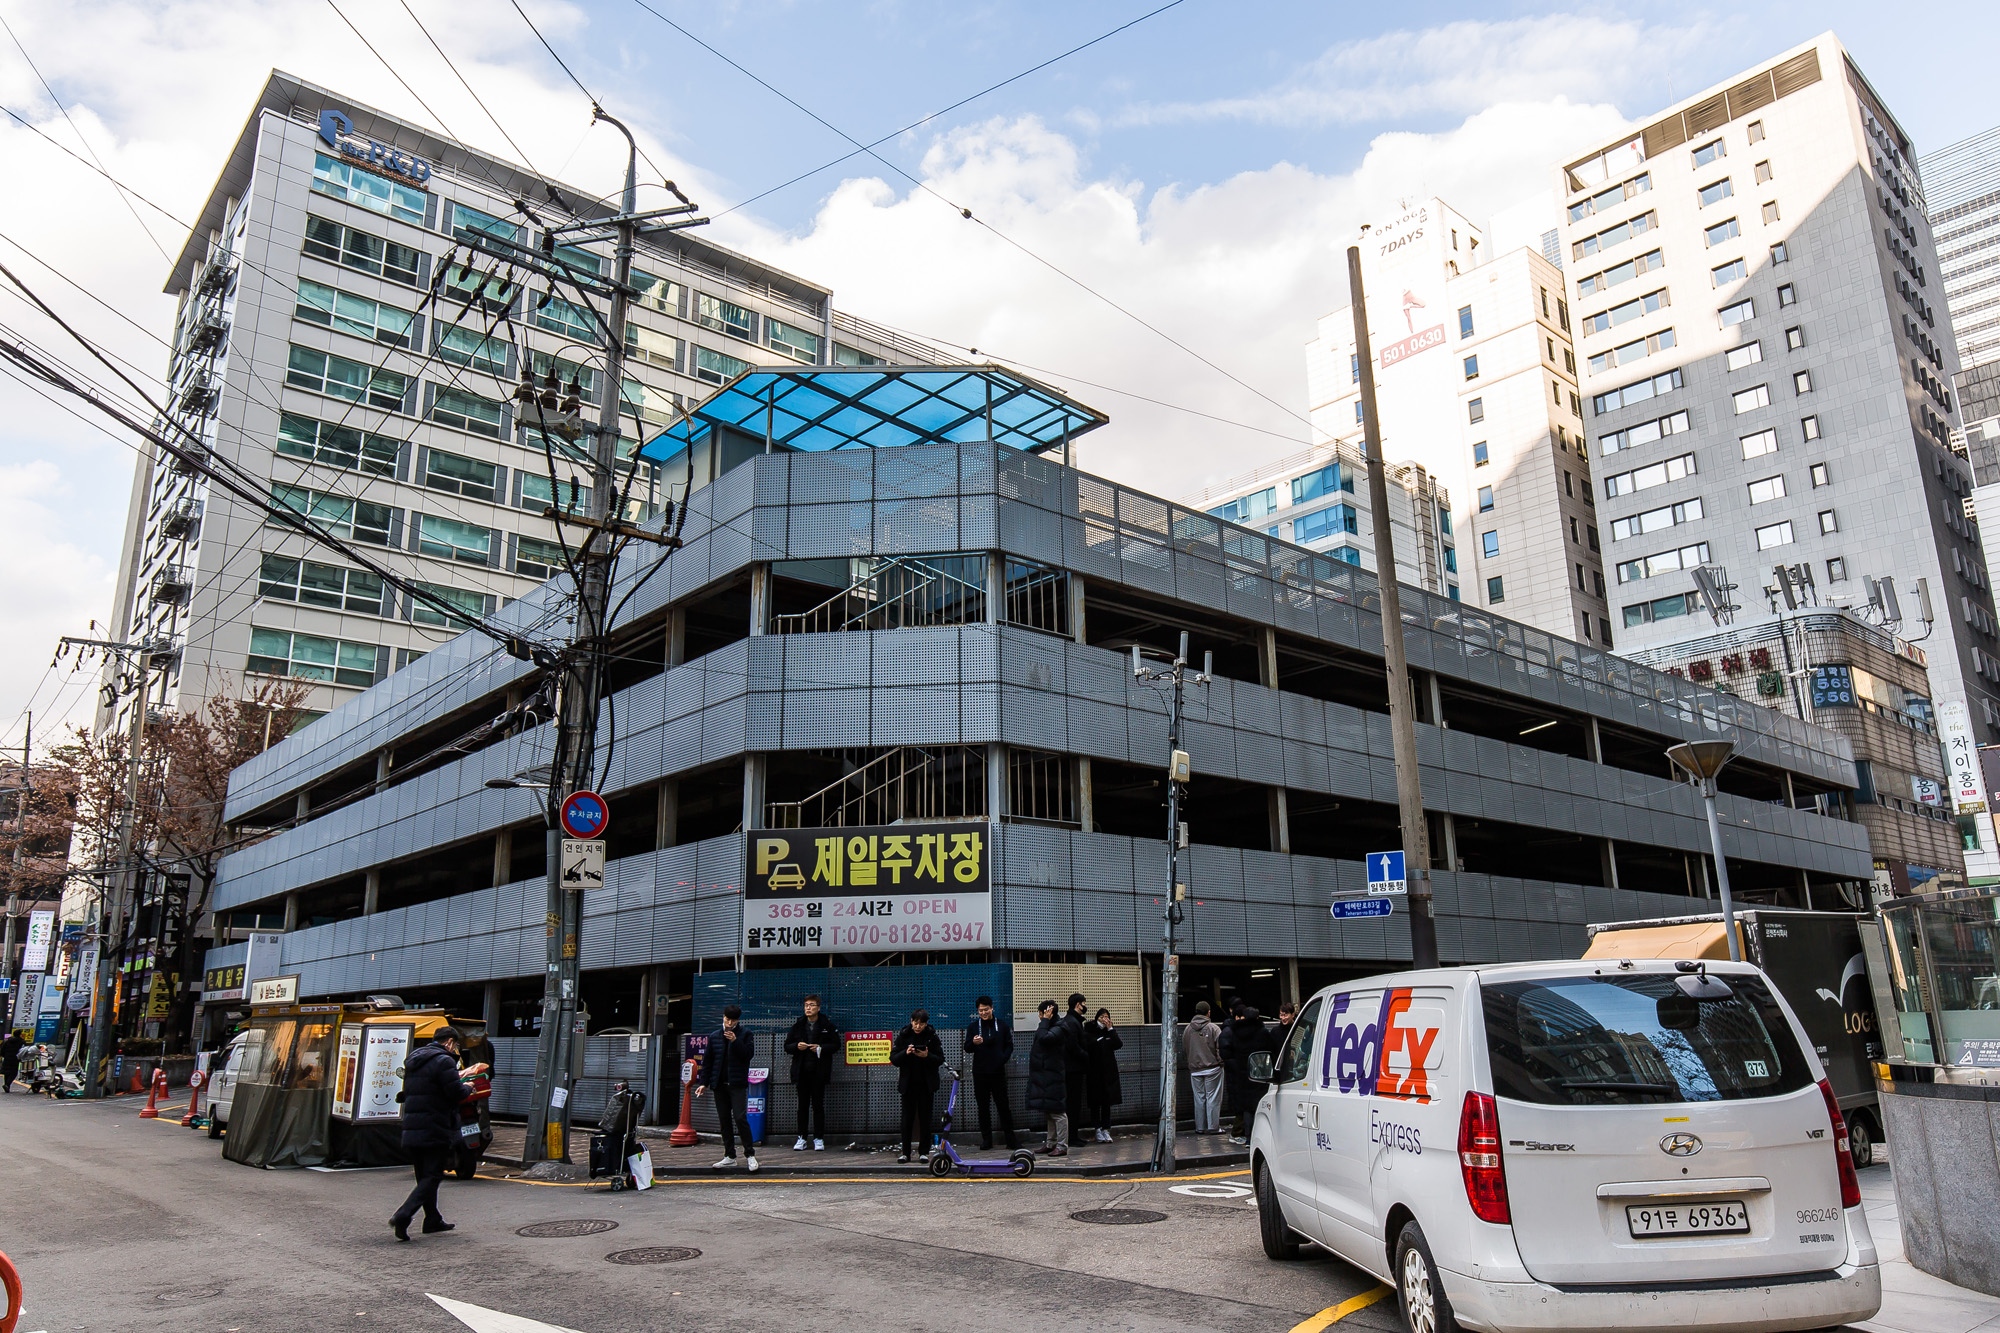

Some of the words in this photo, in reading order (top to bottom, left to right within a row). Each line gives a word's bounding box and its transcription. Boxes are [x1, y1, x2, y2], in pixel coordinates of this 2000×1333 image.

[342, 141, 365, 158] the
[368, 140, 431, 181] P&D
[1375, 224, 1392, 236] ON
[1395, 207, 1426, 226] YOGA
[1380, 228, 1424, 256] 7DAYS
[1383, 328, 1442, 363] 501.0630
[1949, 722, 1964, 732] the
[1952, 735, 1976, 788] 차이홍
[569, 810, 602, 819] 주차금지
[565, 844, 602, 853] 견인지역
[756, 838, 790, 875] P
[811, 831, 983, 887] 제일주차장
[1371, 881, 1403, 892] 일방통행
[768, 902, 823, 919] 365일
[833, 900, 893, 917] 24시간
[903, 899, 957, 915] OPEN
[1345, 901, 1380, 910] 테헤란로83길
[256, 936, 278, 944] 제일
[748, 925, 822, 948] 월주차예약
[831, 922, 984, 945] T:070-8128-3947
[215, 967, 244, 988] 제일주
[20, 985, 36, 1022] 명동칼국수
[1321, 988, 1440, 1105] FedEx
[377, 1060, 392, 1069] 미소를
[1748, 1062, 1765, 1076] 373
[1316, 1131, 1332, 1151] 페덱스
[1371, 1109, 1422, 1155] Express
[1806, 1129, 1825, 1139] VGT
[1525, 1141, 1576, 1152] Starex
[1640, 1210, 1679, 1230] 91무
[1688, 1206, 1736, 1228] 6936
[1796, 1207, 1839, 1224] 966246
[1799, 1234, 1820, 1243] 최대적재량
[1820, 1233, 1835, 1242] 800kg
